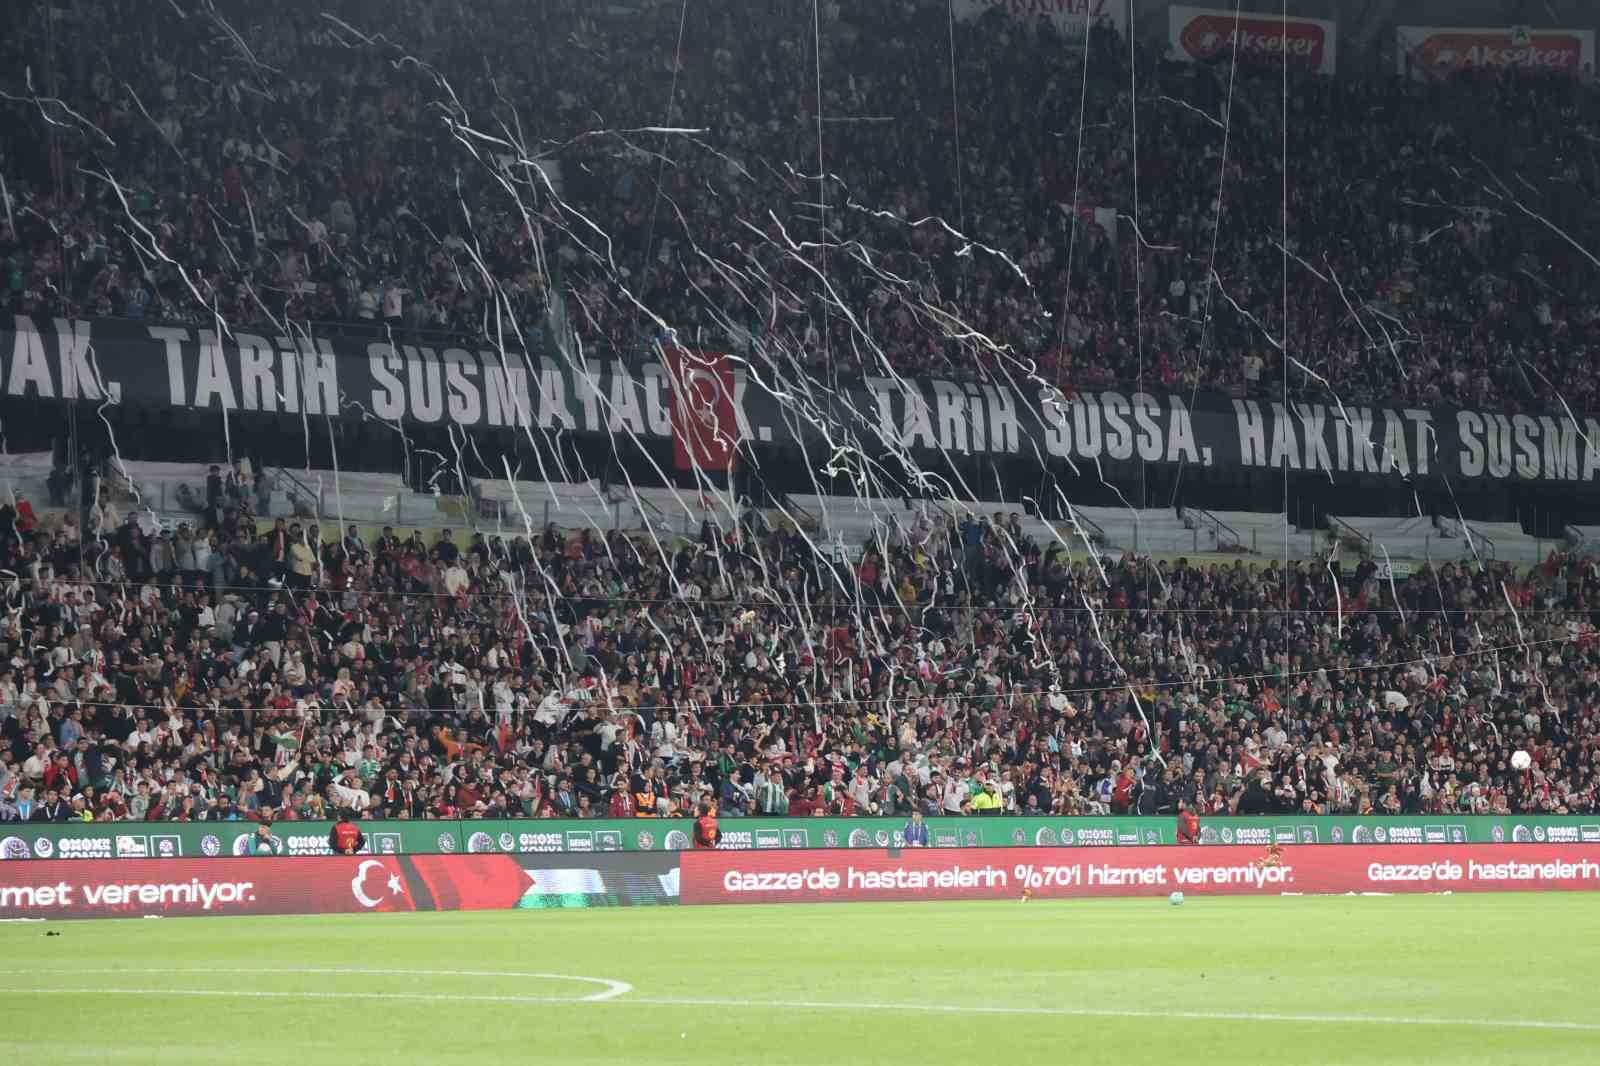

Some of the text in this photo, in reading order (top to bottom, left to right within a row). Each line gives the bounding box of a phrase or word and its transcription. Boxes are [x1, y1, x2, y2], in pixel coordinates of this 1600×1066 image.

[0, 314, 121, 402] AK.
[723, 863, 1295, 892] Gazze'de hastanelerin %70'i hizmet veremiyor.
[1367, 858, 1600, 881] Gazze'de hastanelerin
[0, 878, 255, 909] met veremiyor.
